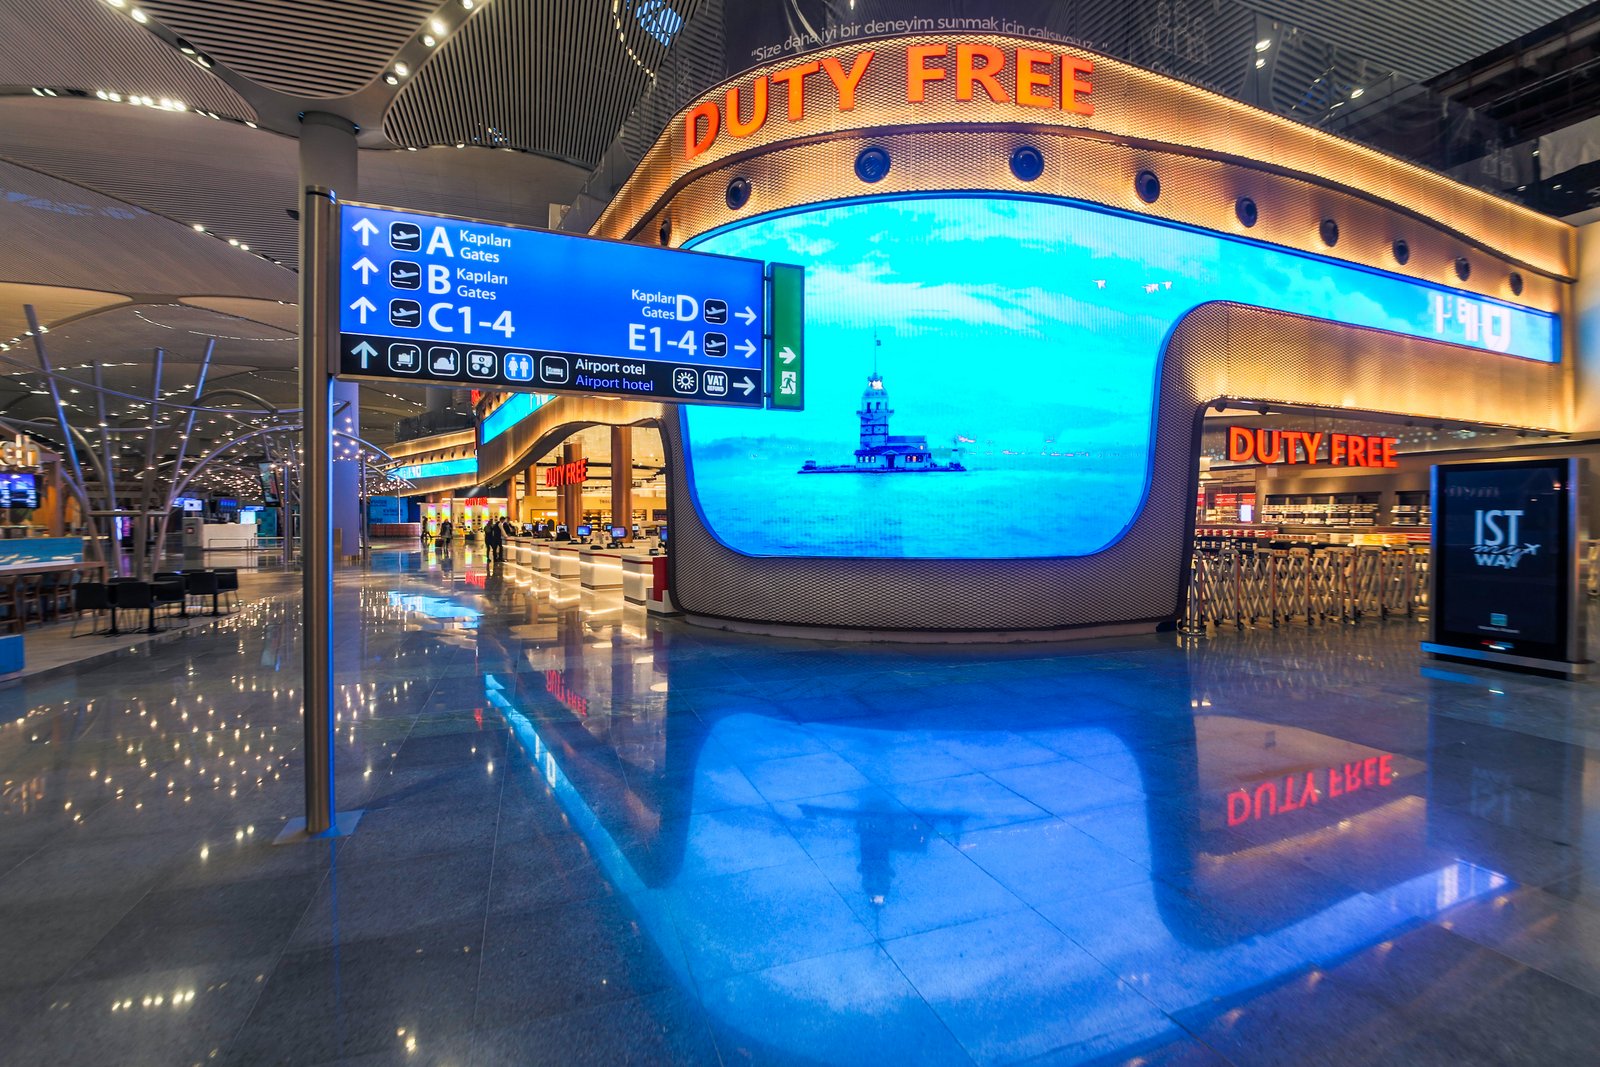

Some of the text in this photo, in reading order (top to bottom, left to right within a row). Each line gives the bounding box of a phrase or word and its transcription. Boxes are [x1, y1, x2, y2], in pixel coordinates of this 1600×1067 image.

[784, 34, 820, 48] daha
[821, 25, 837, 43] iyi
[840, 22, 861, 38] bir
[864, 16, 934, 34] deneyim
[937, 16, 999, 31] sunmak
[685, 43, 1095, 161] DUTY FREE
[426, 226, 511, 257] A Kapıları
[460, 247, 500, 263] Gates
[428, 264, 508, 295] B Kapıları
[457, 285, 497, 300] Gates
[428, 302, 516, 338] C1-4
[631, 289, 699, 322] Kapıları D
[642, 306, 675, 320] Gates
[629, 323, 698, 356] E1-4
[575, 358, 646, 375] Airport otel
[706, 374, 725, 386] VAT
[575, 374, 654, 391] Airport hotel
[1228, 426, 1398, 468] DUTY FREE
[545, 457, 587, 488] DUTY FREE
[1474, 509, 1524, 547] IST
[1473, 553, 1518, 568] WAY
